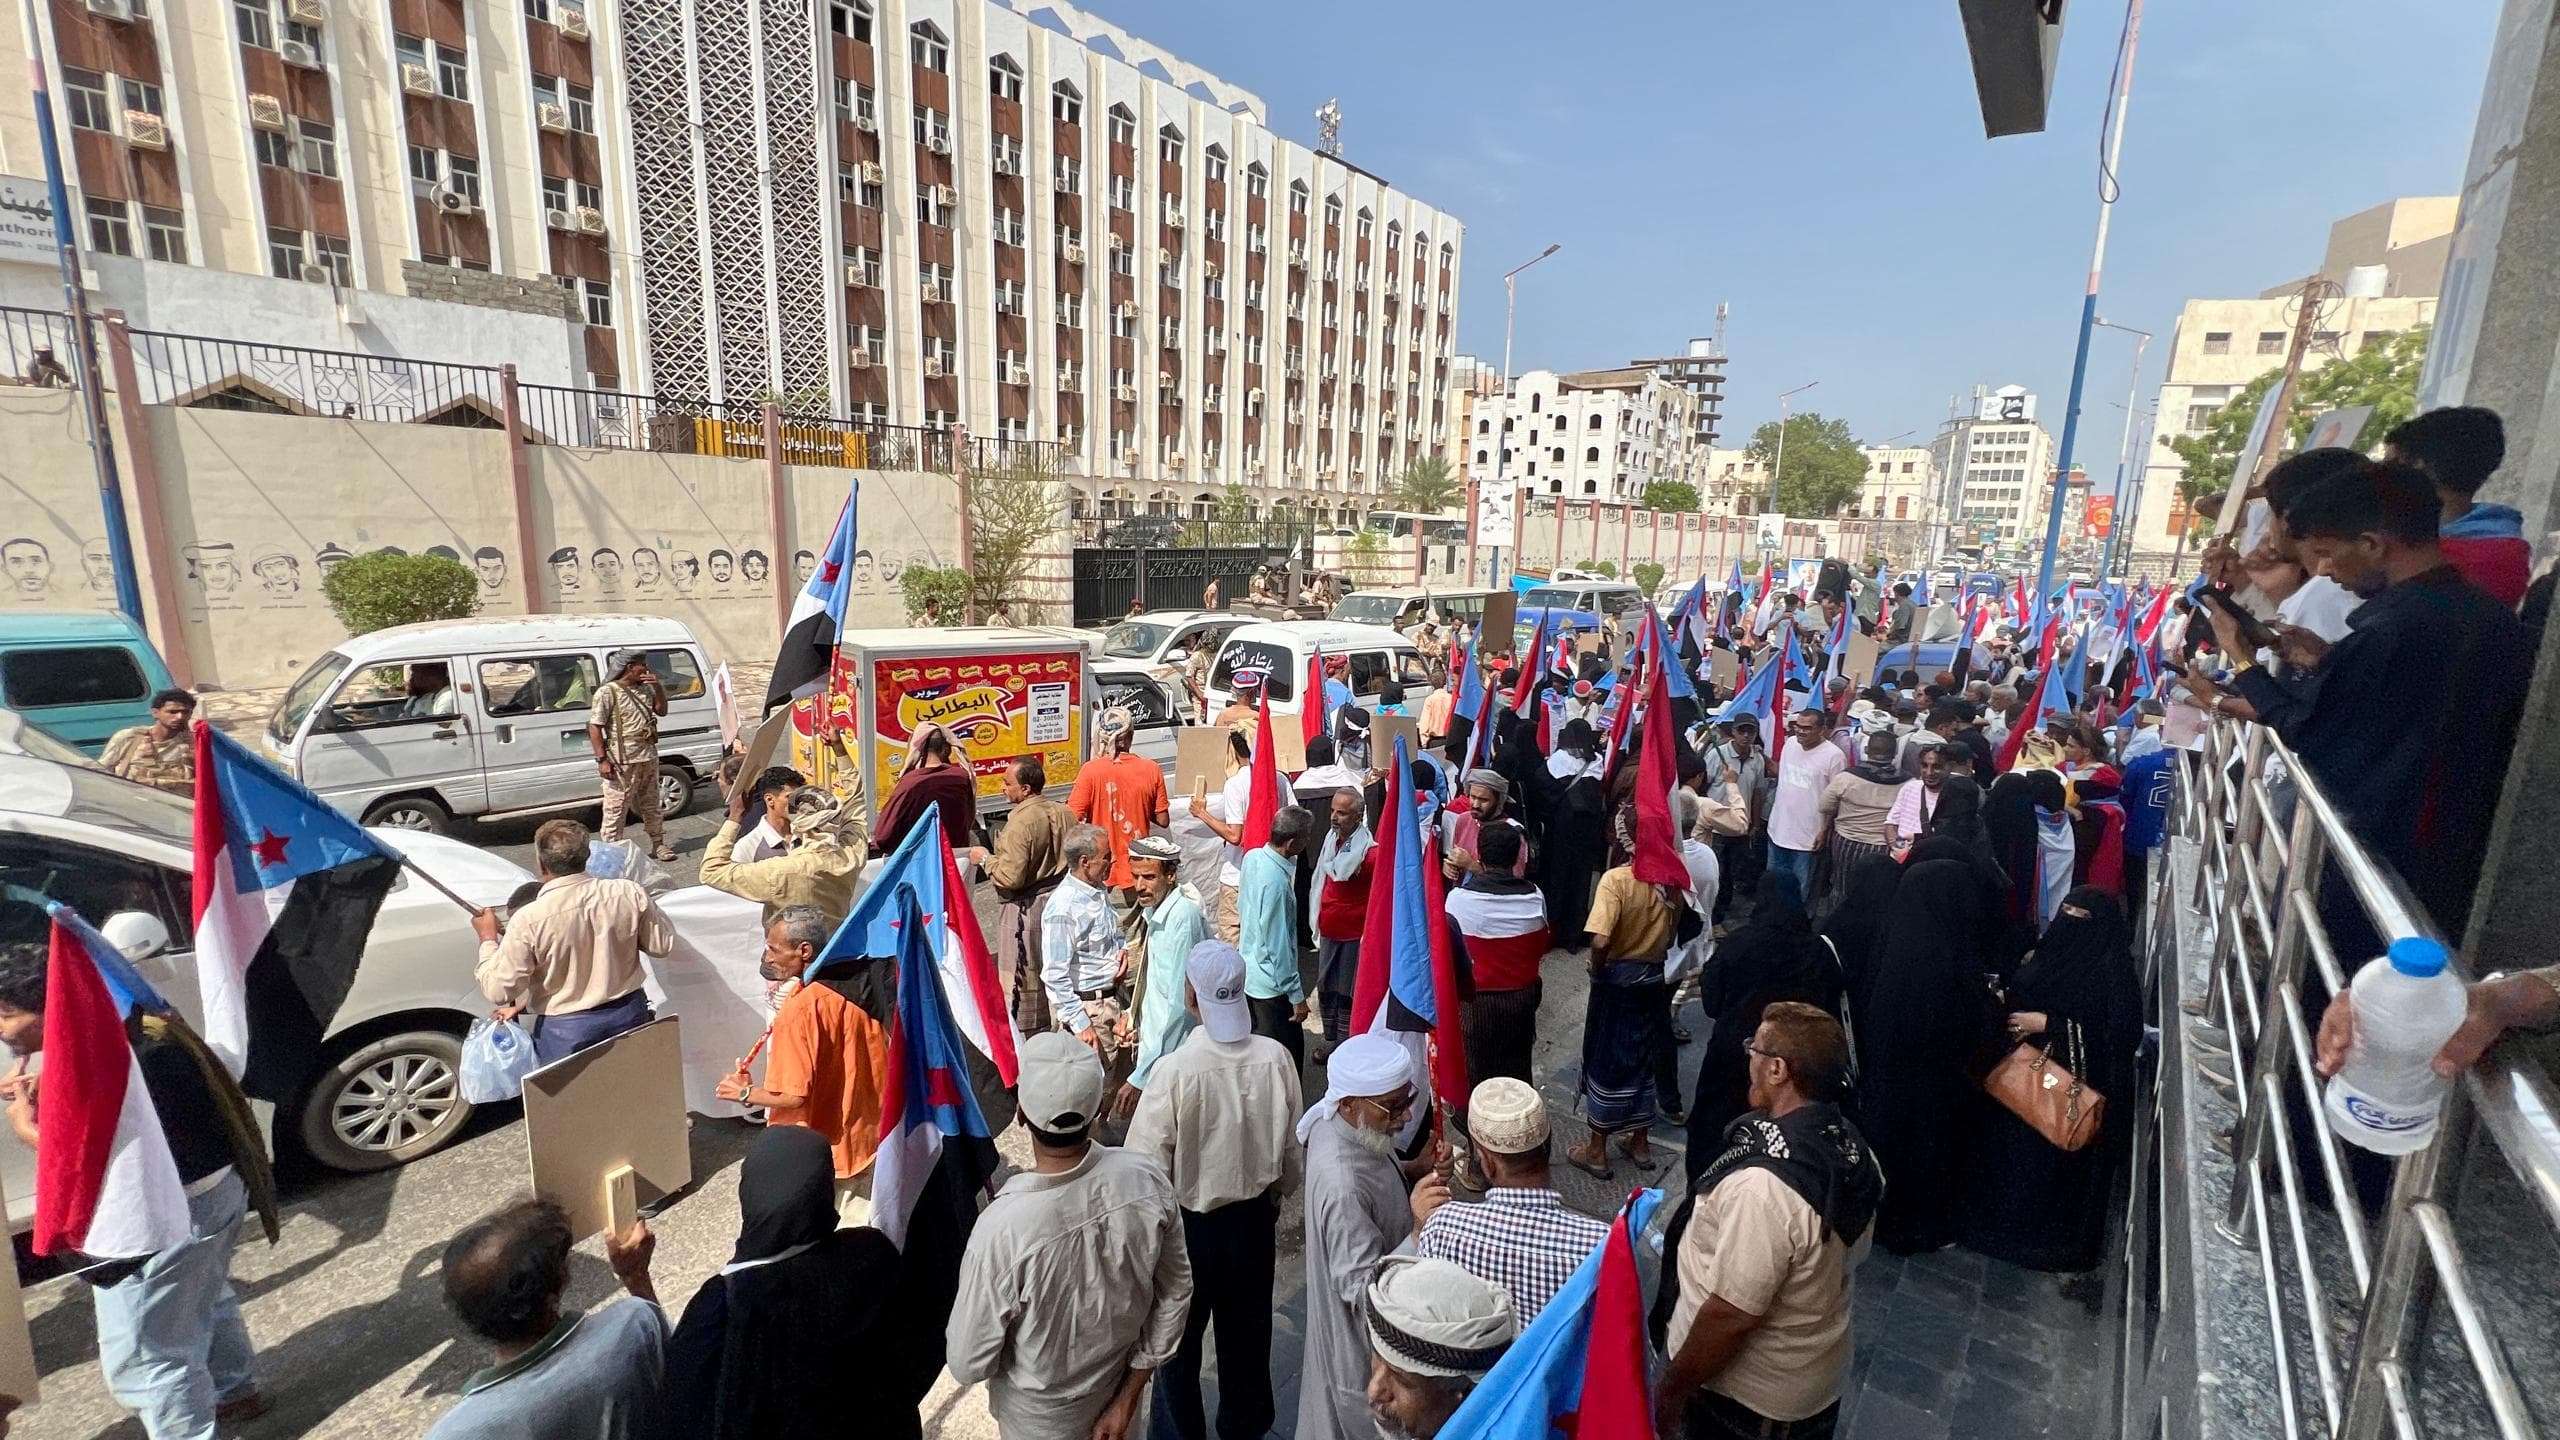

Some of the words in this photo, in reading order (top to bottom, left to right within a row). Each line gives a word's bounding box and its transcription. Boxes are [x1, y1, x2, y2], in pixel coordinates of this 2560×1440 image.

[1230, 652, 1246, 668] الله
[914, 690, 940, 698] سوبر
[916, 694, 990, 722] البطاطي
